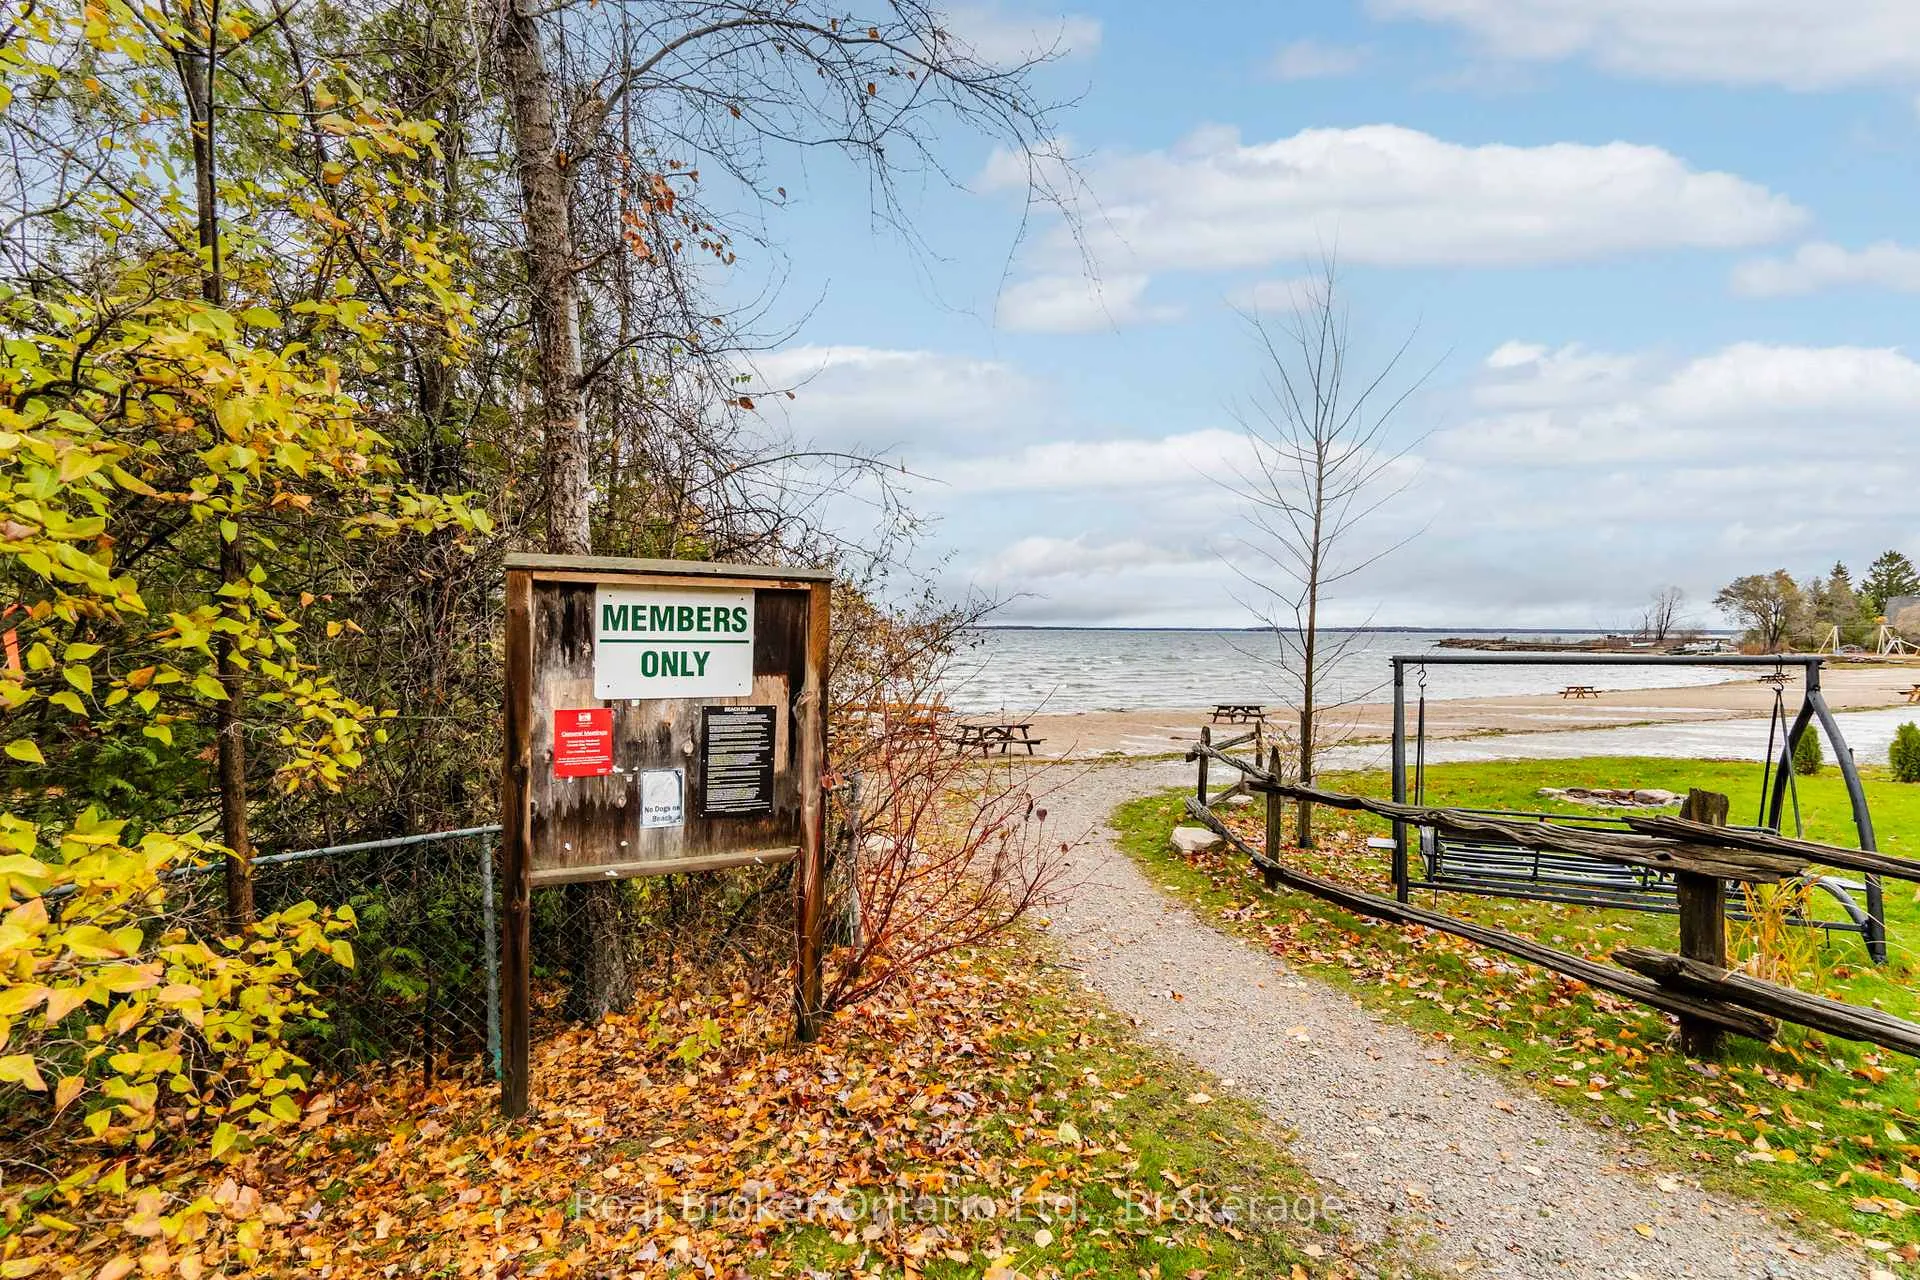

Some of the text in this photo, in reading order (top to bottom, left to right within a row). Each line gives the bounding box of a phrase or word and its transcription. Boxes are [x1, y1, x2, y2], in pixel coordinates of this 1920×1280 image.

[602, 604, 748, 633] MEMBERS
[641, 650, 711, 677] ONLY
[655, 805, 670, 813] Dogs
